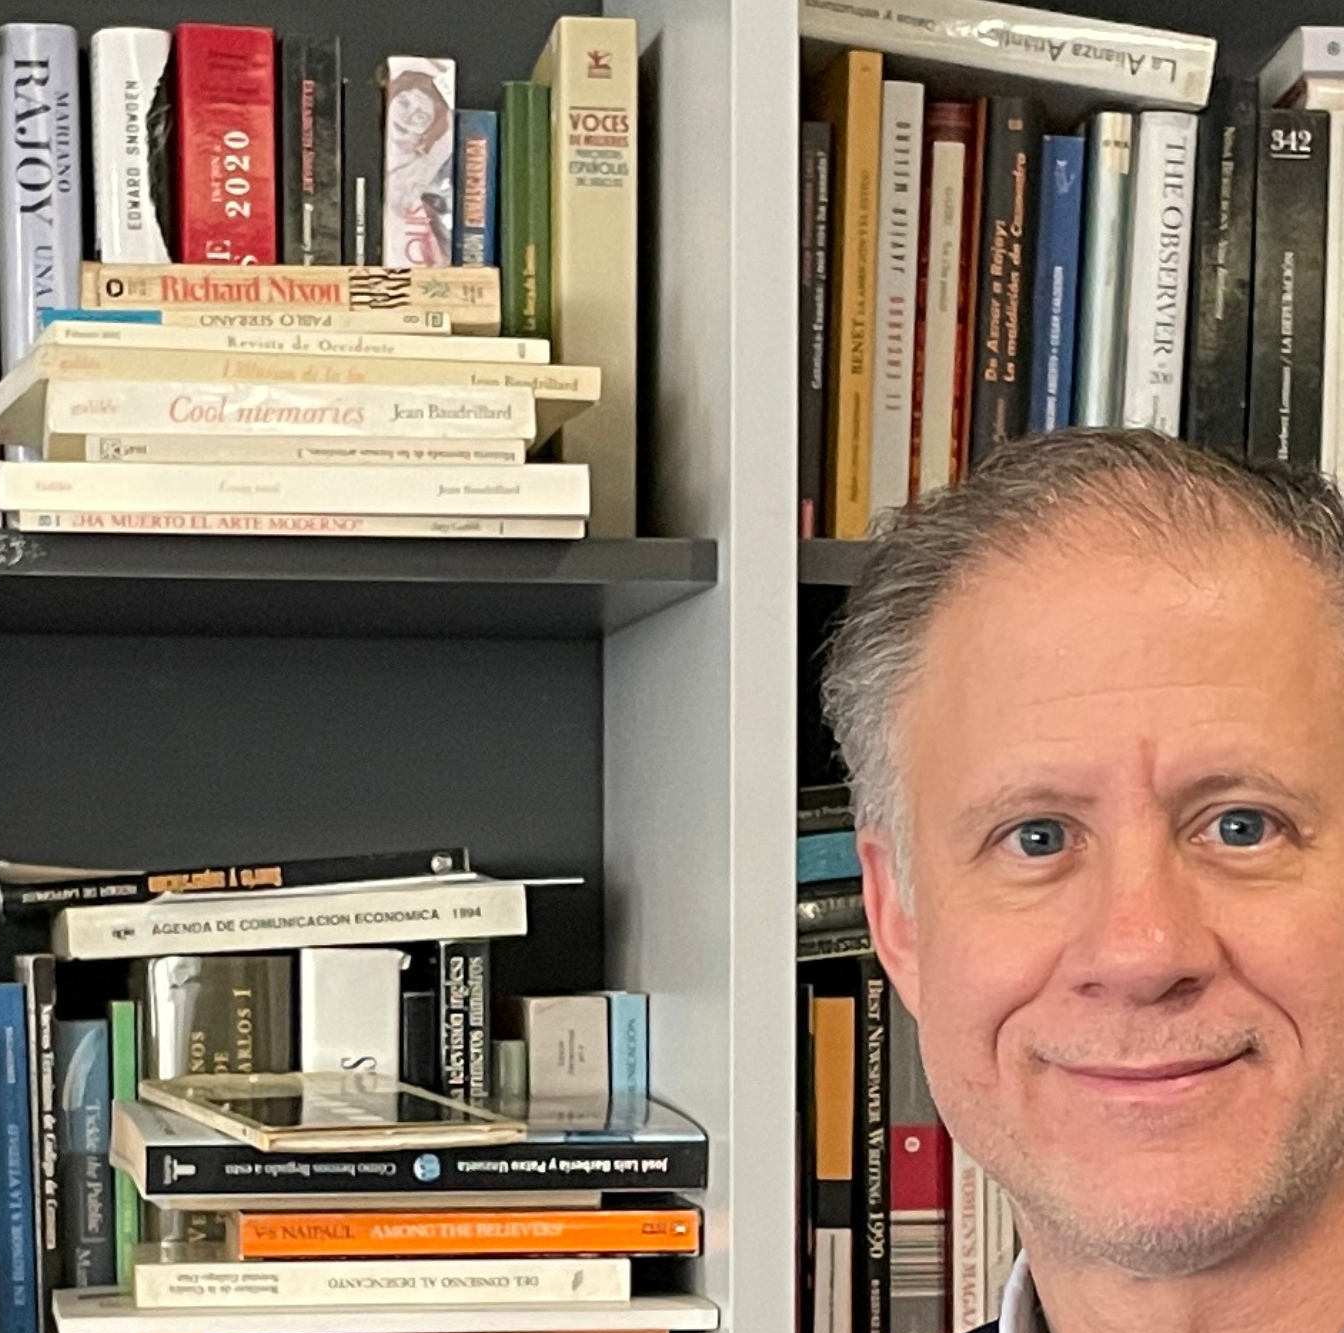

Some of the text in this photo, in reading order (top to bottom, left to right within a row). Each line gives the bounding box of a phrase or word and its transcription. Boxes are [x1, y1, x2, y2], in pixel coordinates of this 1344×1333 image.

[54, 91, 72, 194] MARIANO
[568, 113, 630, 133] VOCES
[1269, 129, 1312, 151] 342
[13, 56, 55, 297] RAJOY UNA
[124, 80, 142, 230] EDWARD SNOWDEN
[223, 129, 252, 217] 2020
[1152, 136, 1188, 356] THE OBSERVER
[158, 273, 342, 304] Richard Nixon
[199, 313, 332, 327] PABLO SERRANO
[166, 394, 367, 425] Cool memories
[151, 921, 212, 935] AGENDA
[215, 920, 235, 933] DE
[238, 914, 351, 931] COMUNICACION
[445, 956, 468, 1010] inglesa
[467, 956, 486, 1027] ministros
[83, 1098, 103, 1151] Tickle
[866, 978, 886, 1259] BEST NEWSPAPER WRITING 1990
[83, 1156, 102, 1178] the
